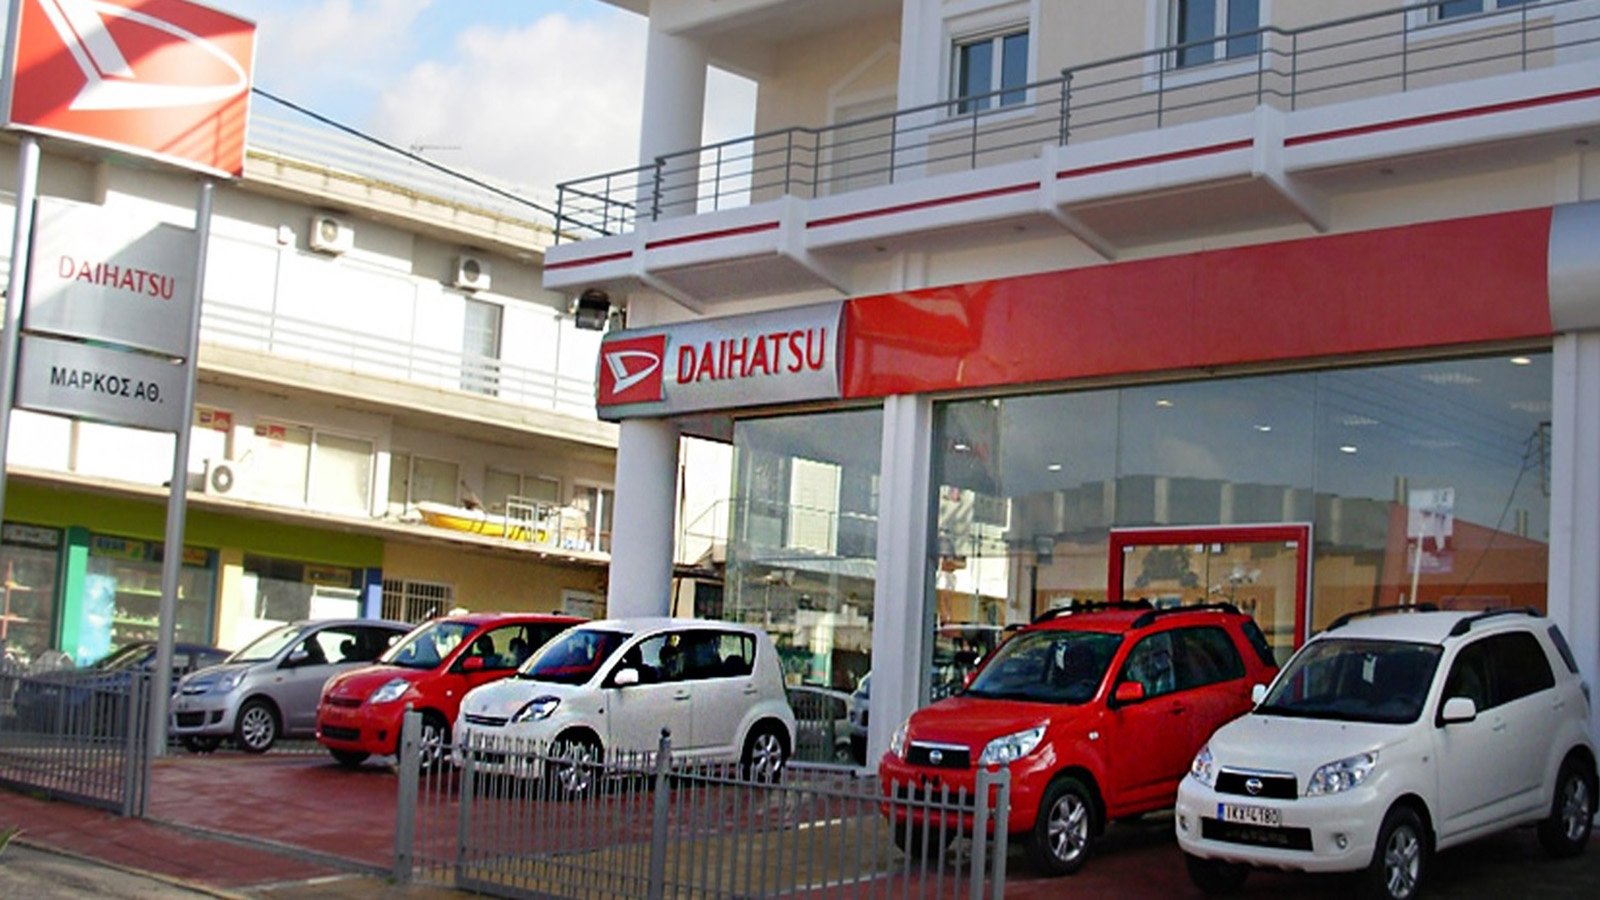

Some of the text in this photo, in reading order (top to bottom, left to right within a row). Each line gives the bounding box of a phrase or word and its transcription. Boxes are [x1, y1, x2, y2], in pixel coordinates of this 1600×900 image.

[59, 255, 175, 300] DAIHATSU
[677, 327, 826, 384] DAIHATSU
[51, 366, 130, 397] ΜΑΡΚΟΣ
